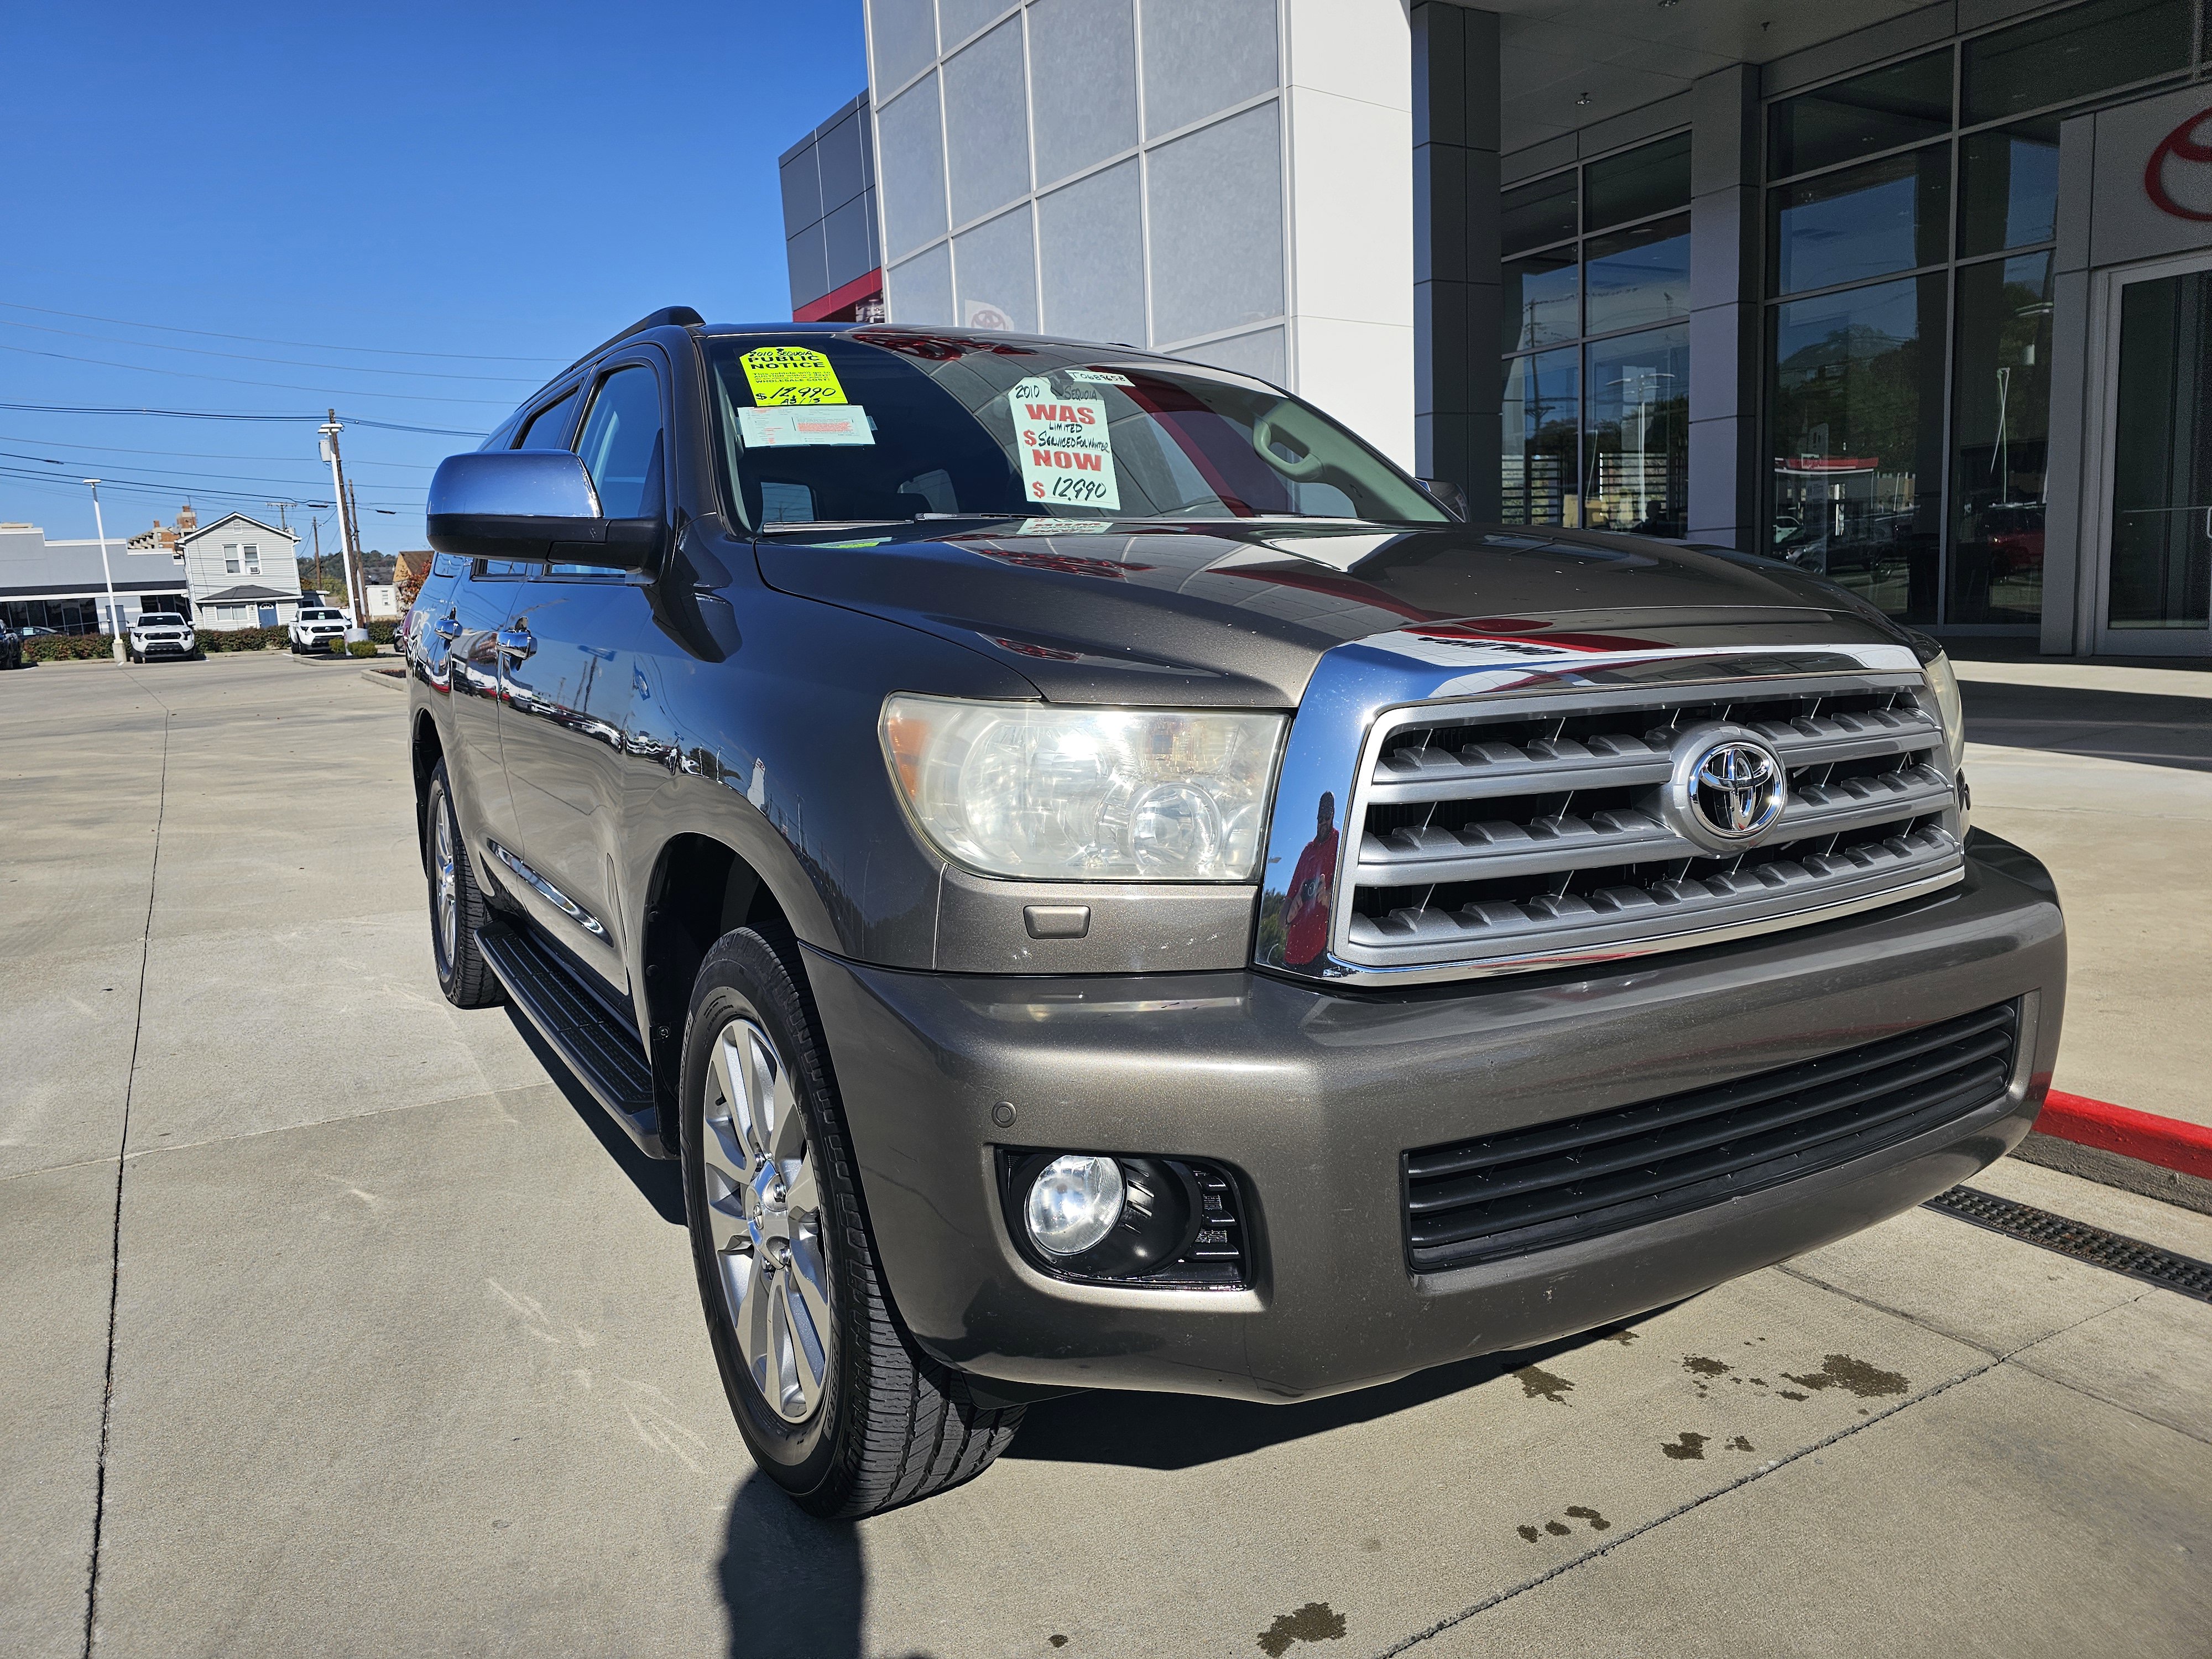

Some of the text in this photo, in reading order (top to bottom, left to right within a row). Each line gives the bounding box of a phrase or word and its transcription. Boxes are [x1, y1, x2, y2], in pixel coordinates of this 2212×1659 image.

[1015, 384, 1040, 399] 2010
[1025, 404, 1096, 425] WAS
[1049, 421, 1082, 433] LIMITED
[1023, 429, 1037, 447] $
[1032, 449, 1102, 472] NOW
[1032, 481, 1046, 499] $
